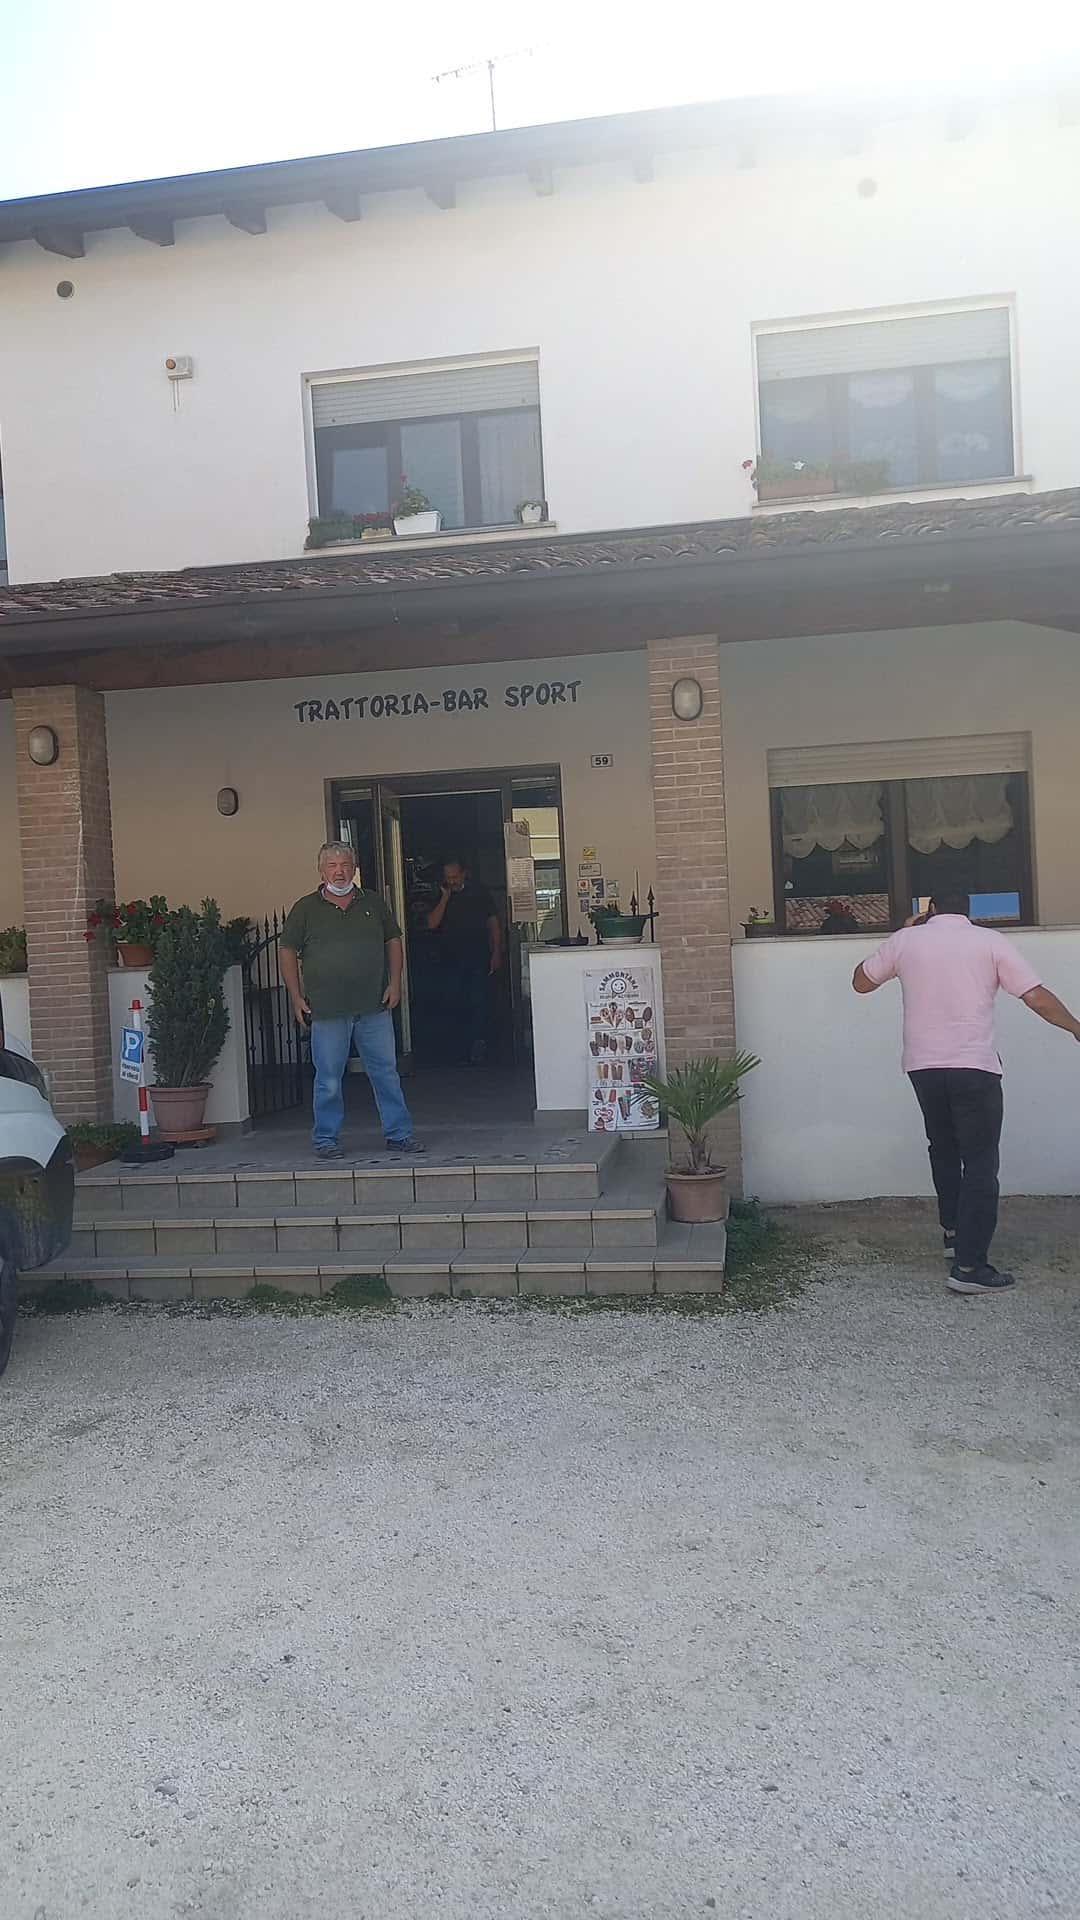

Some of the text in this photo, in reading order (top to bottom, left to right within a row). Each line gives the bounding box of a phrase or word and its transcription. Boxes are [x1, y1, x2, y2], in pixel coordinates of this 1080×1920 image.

[294, 680, 582, 723] TRATTORIA-BAR SPORT
[595, 756, 609, 766] 59
[125, 1031, 141, 1059] P
